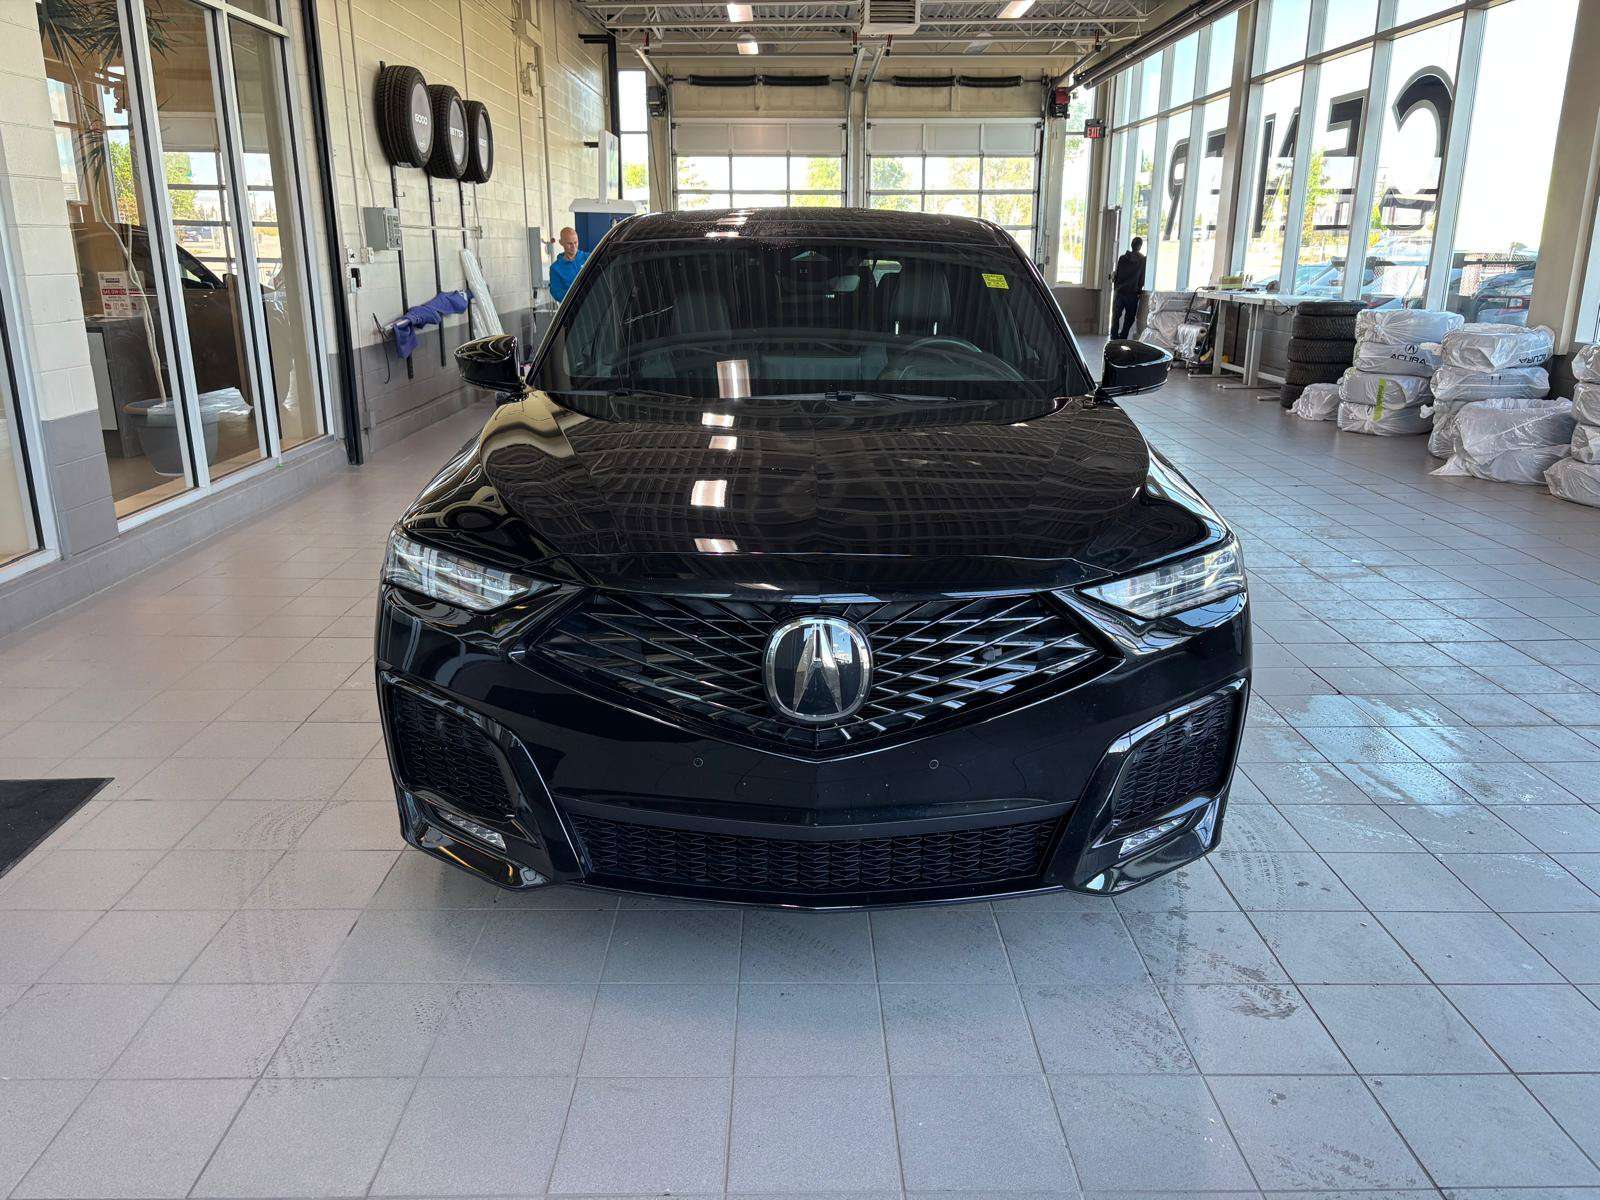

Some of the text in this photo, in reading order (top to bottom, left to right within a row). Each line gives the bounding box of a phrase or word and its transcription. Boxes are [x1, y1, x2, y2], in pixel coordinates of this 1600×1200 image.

[414, 113, 428, 125] GOOD
[1087, 127, 1101, 138] EXIT
[1390, 353, 1427, 365] ACURA
[1519, 353, 1547, 364] ACURA
